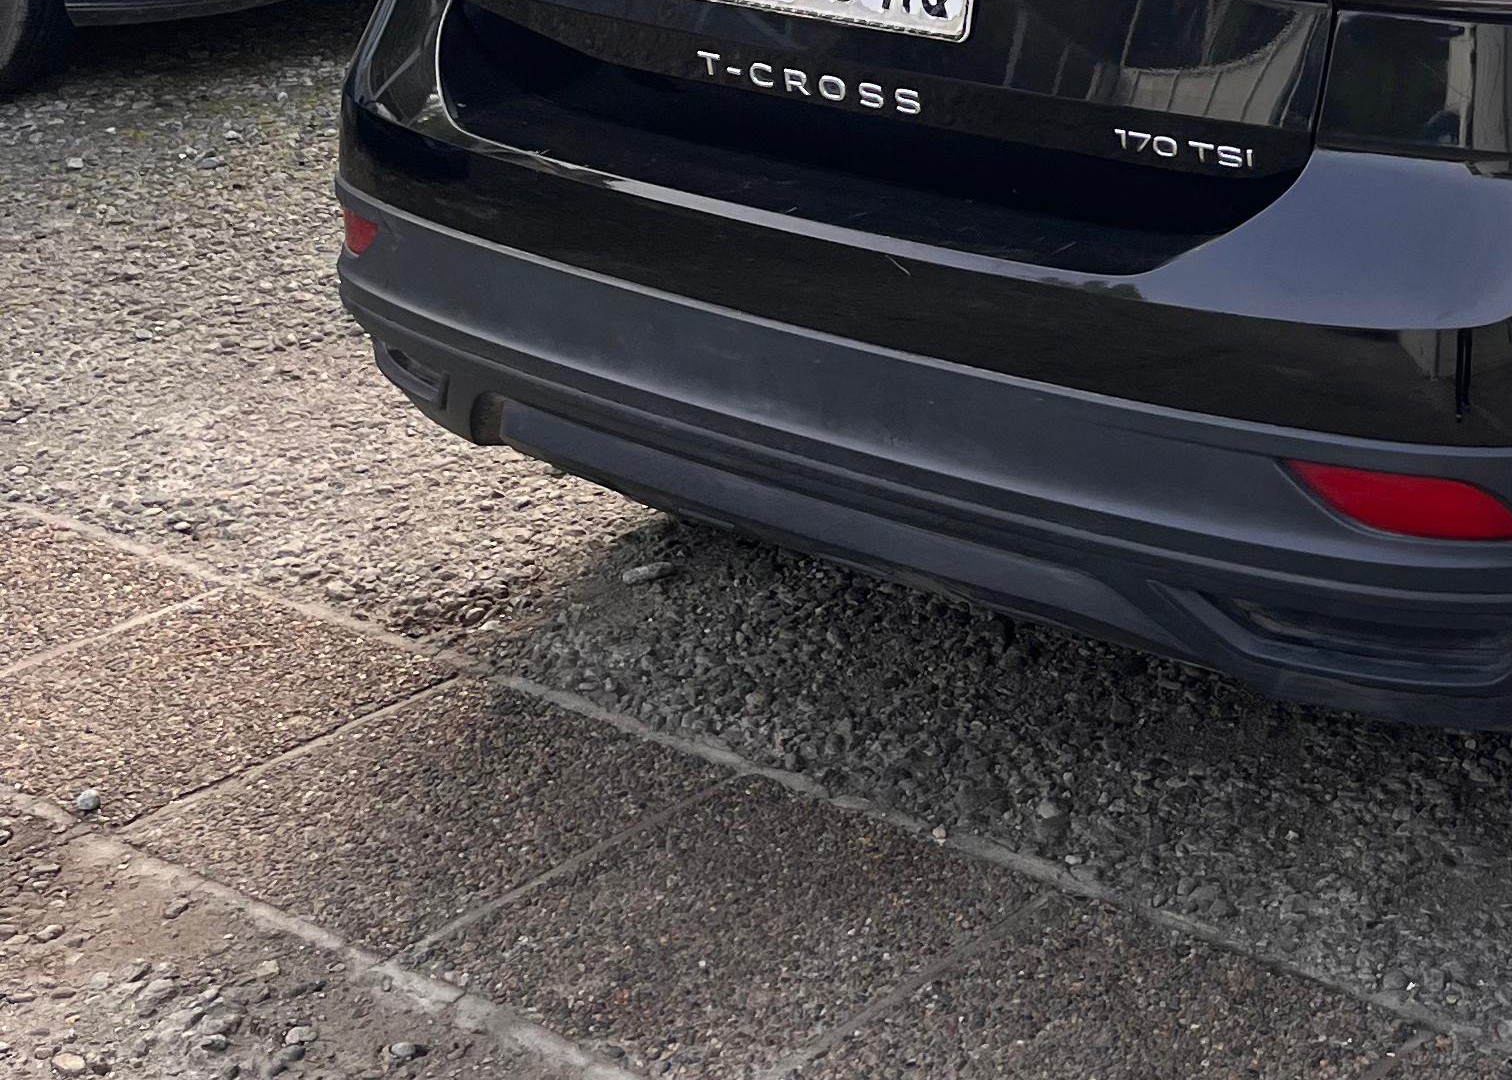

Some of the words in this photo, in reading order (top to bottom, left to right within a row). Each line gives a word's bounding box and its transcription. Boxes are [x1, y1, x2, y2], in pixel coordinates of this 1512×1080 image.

[696, 50, 921, 115] T-CROSS
[1114, 128, 1178, 157] 170
[1188, 140, 1254, 168] TSI
